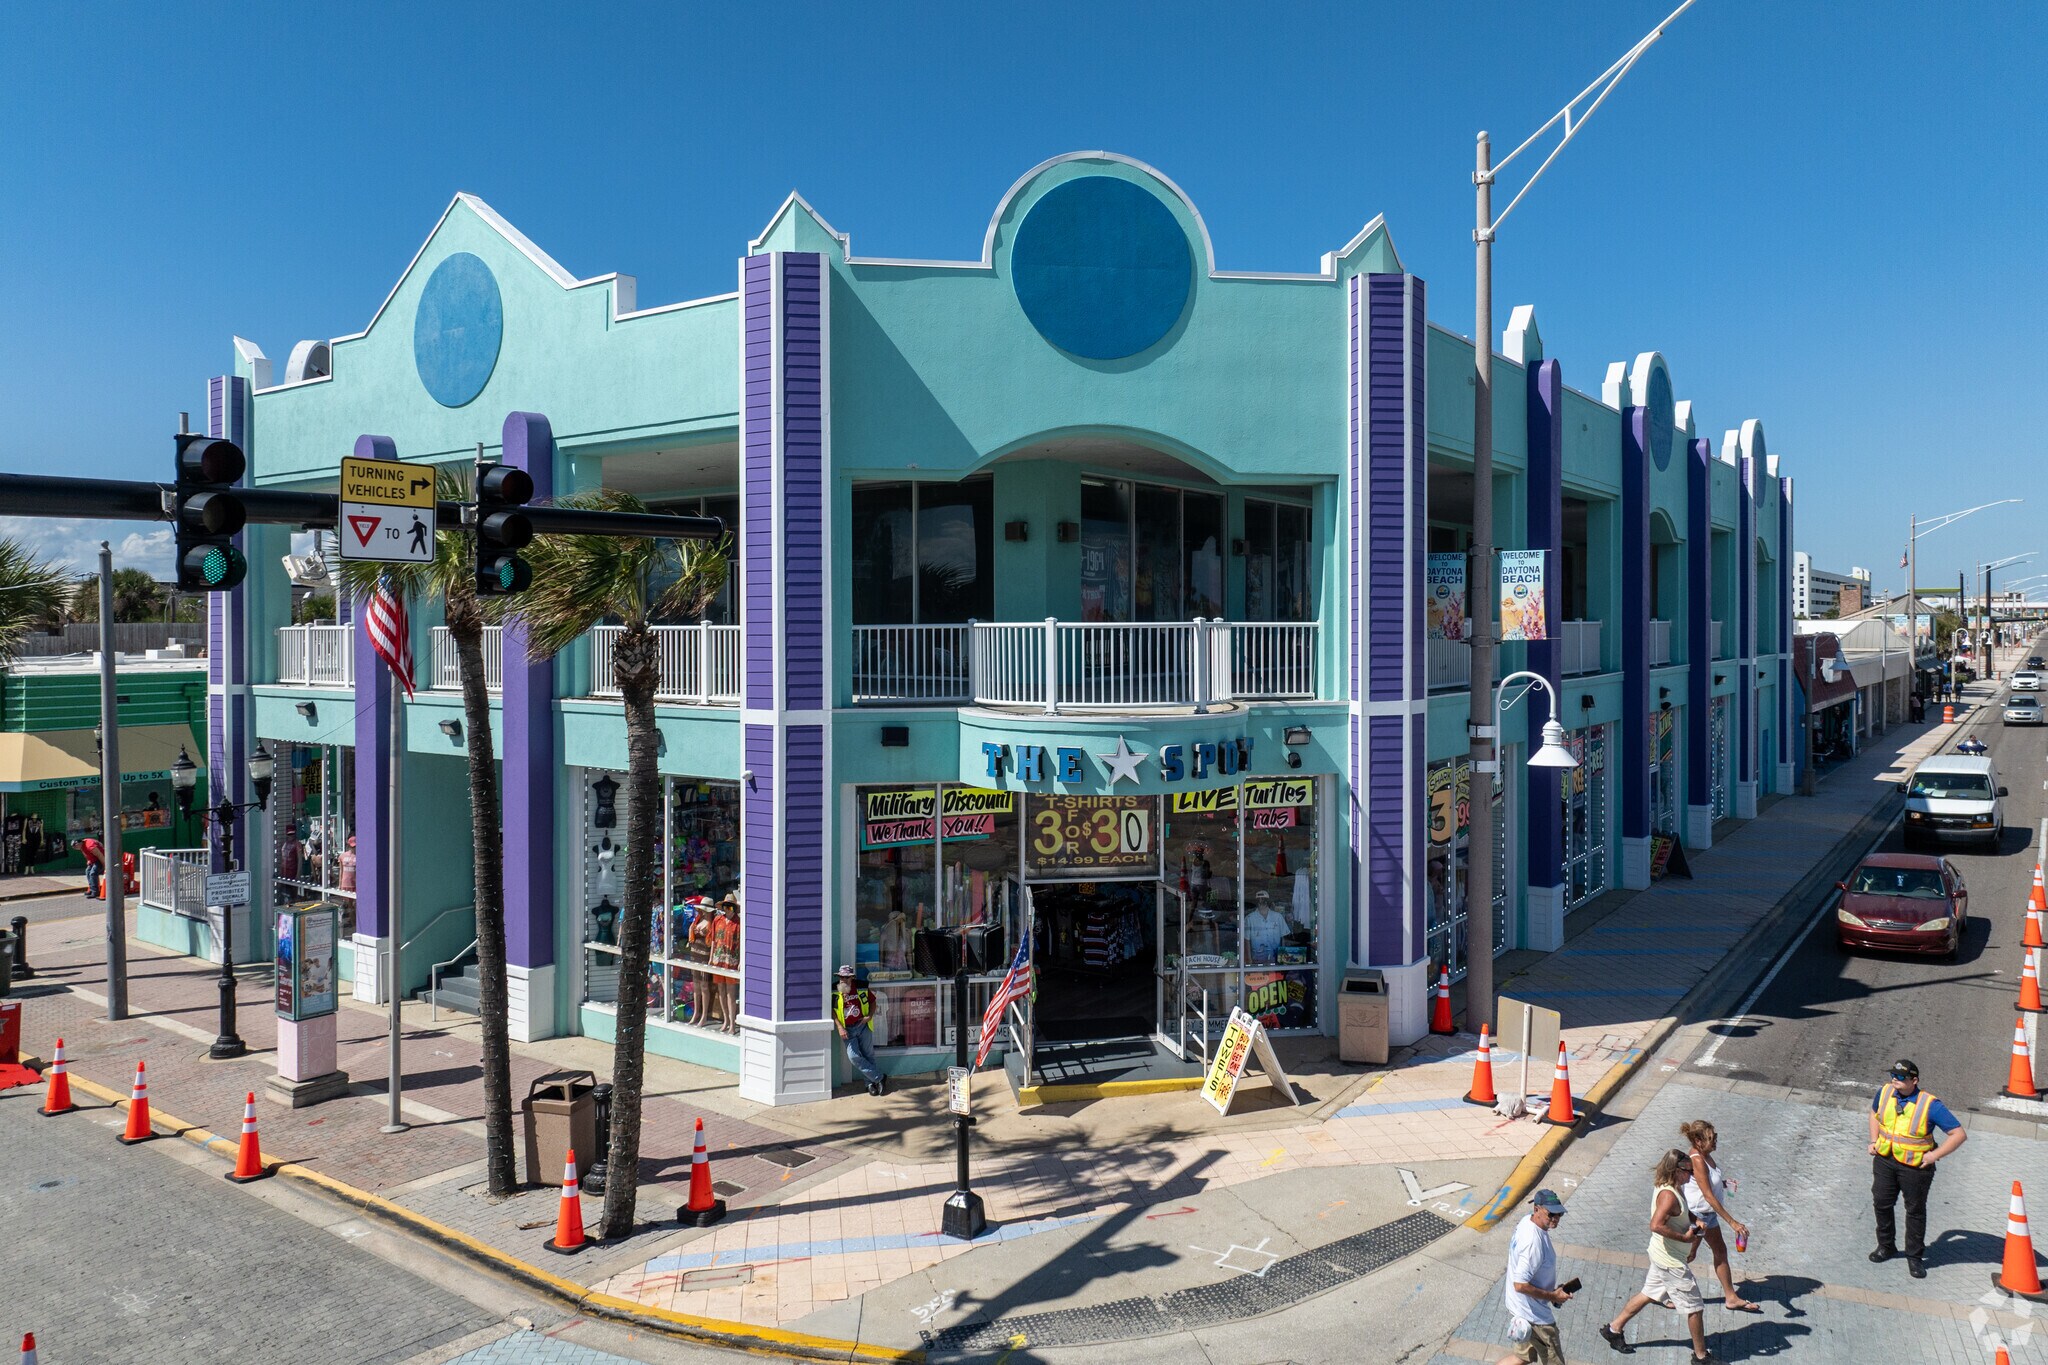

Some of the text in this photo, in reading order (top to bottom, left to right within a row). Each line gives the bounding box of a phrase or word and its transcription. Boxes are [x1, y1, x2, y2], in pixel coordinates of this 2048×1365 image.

[350, 466, 404, 481] TURNING
[347, 484, 406, 499] VEHICLES
[385, 528, 400, 539] TO
[1502, 551, 1540, 559] WELCOME
[1502, 566, 1540, 574] DAYTONA
[1502, 574, 1540, 583] BEACH
[982, 737, 1254, 783] THE SPOT
[40, 780, 78, 789] Custom
[303, 784, 322, 794] FRE
[1178, 781, 1306, 810] LIVE Turtles
[869, 790, 1012, 818] Military Discount
[1045, 796, 1138, 809] T-SHIRTS
[1034, 810, 1064, 855] 3
[1037, 855, 1147, 866] $14.99 EACH
[1249, 980, 1288, 1013] OPEN
[951, 1029, 976, 1041] ERY
[1210, 1026, 1238, 1091] TOWELS
